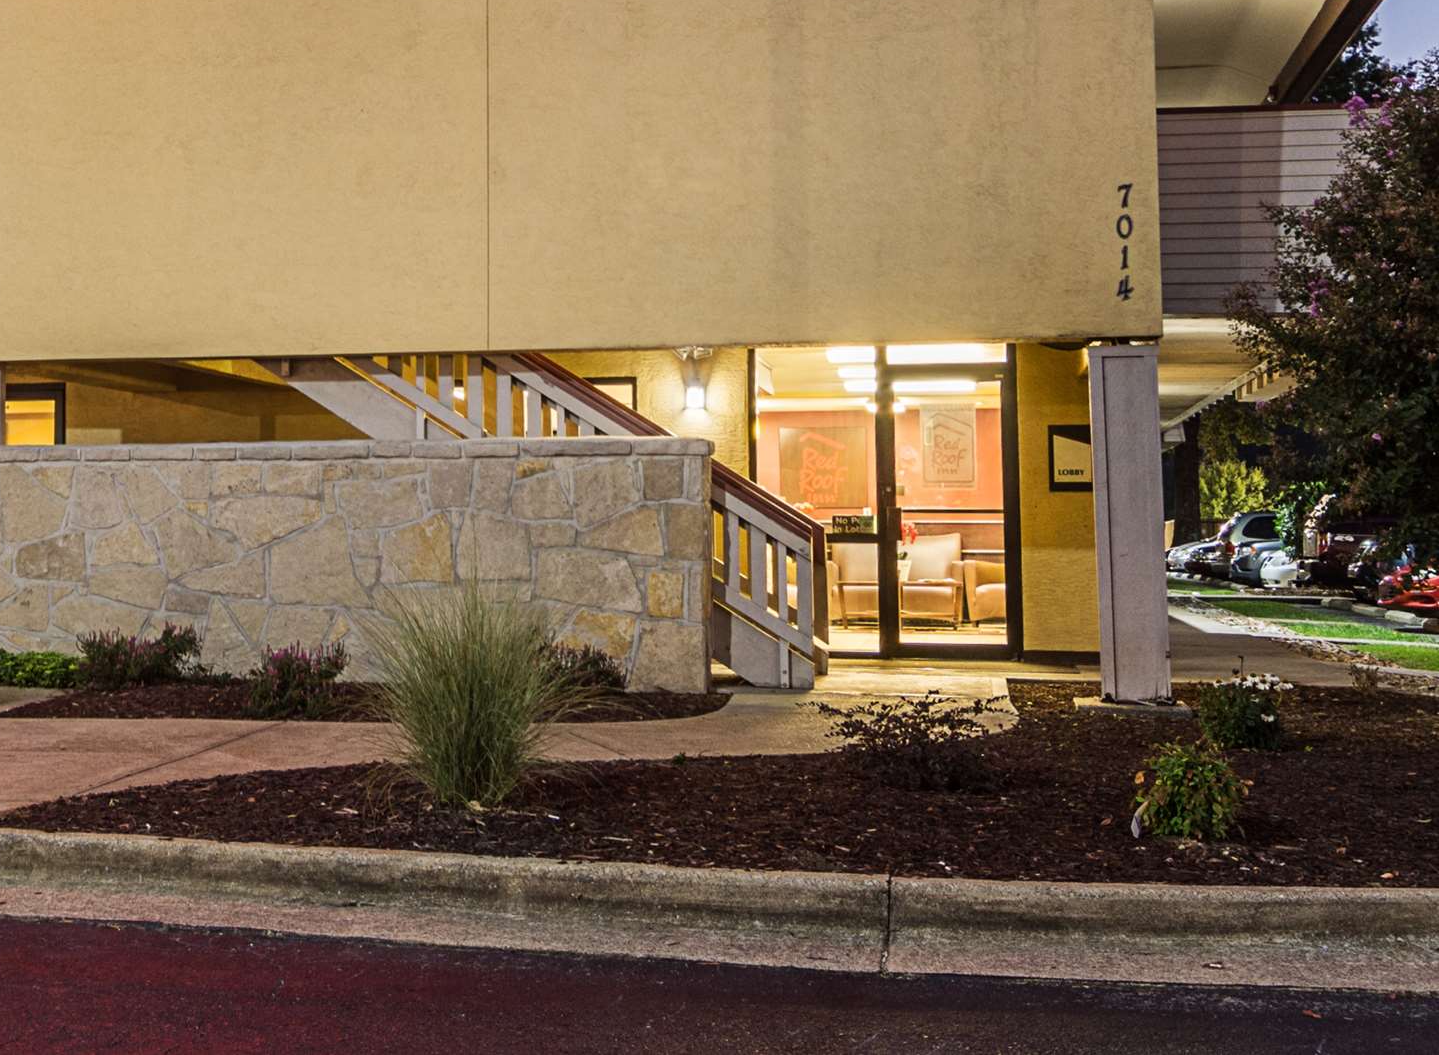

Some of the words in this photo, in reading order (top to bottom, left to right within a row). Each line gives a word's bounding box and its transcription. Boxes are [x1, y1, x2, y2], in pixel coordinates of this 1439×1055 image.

[1116, 183, 1134, 301] 7014
[934, 434, 961, 450] Red
[802, 447, 838, 470] Red
[931, 449, 968, 468] Roof
[799, 466, 848, 494] Roof
[835, 517, 848, 525] No
